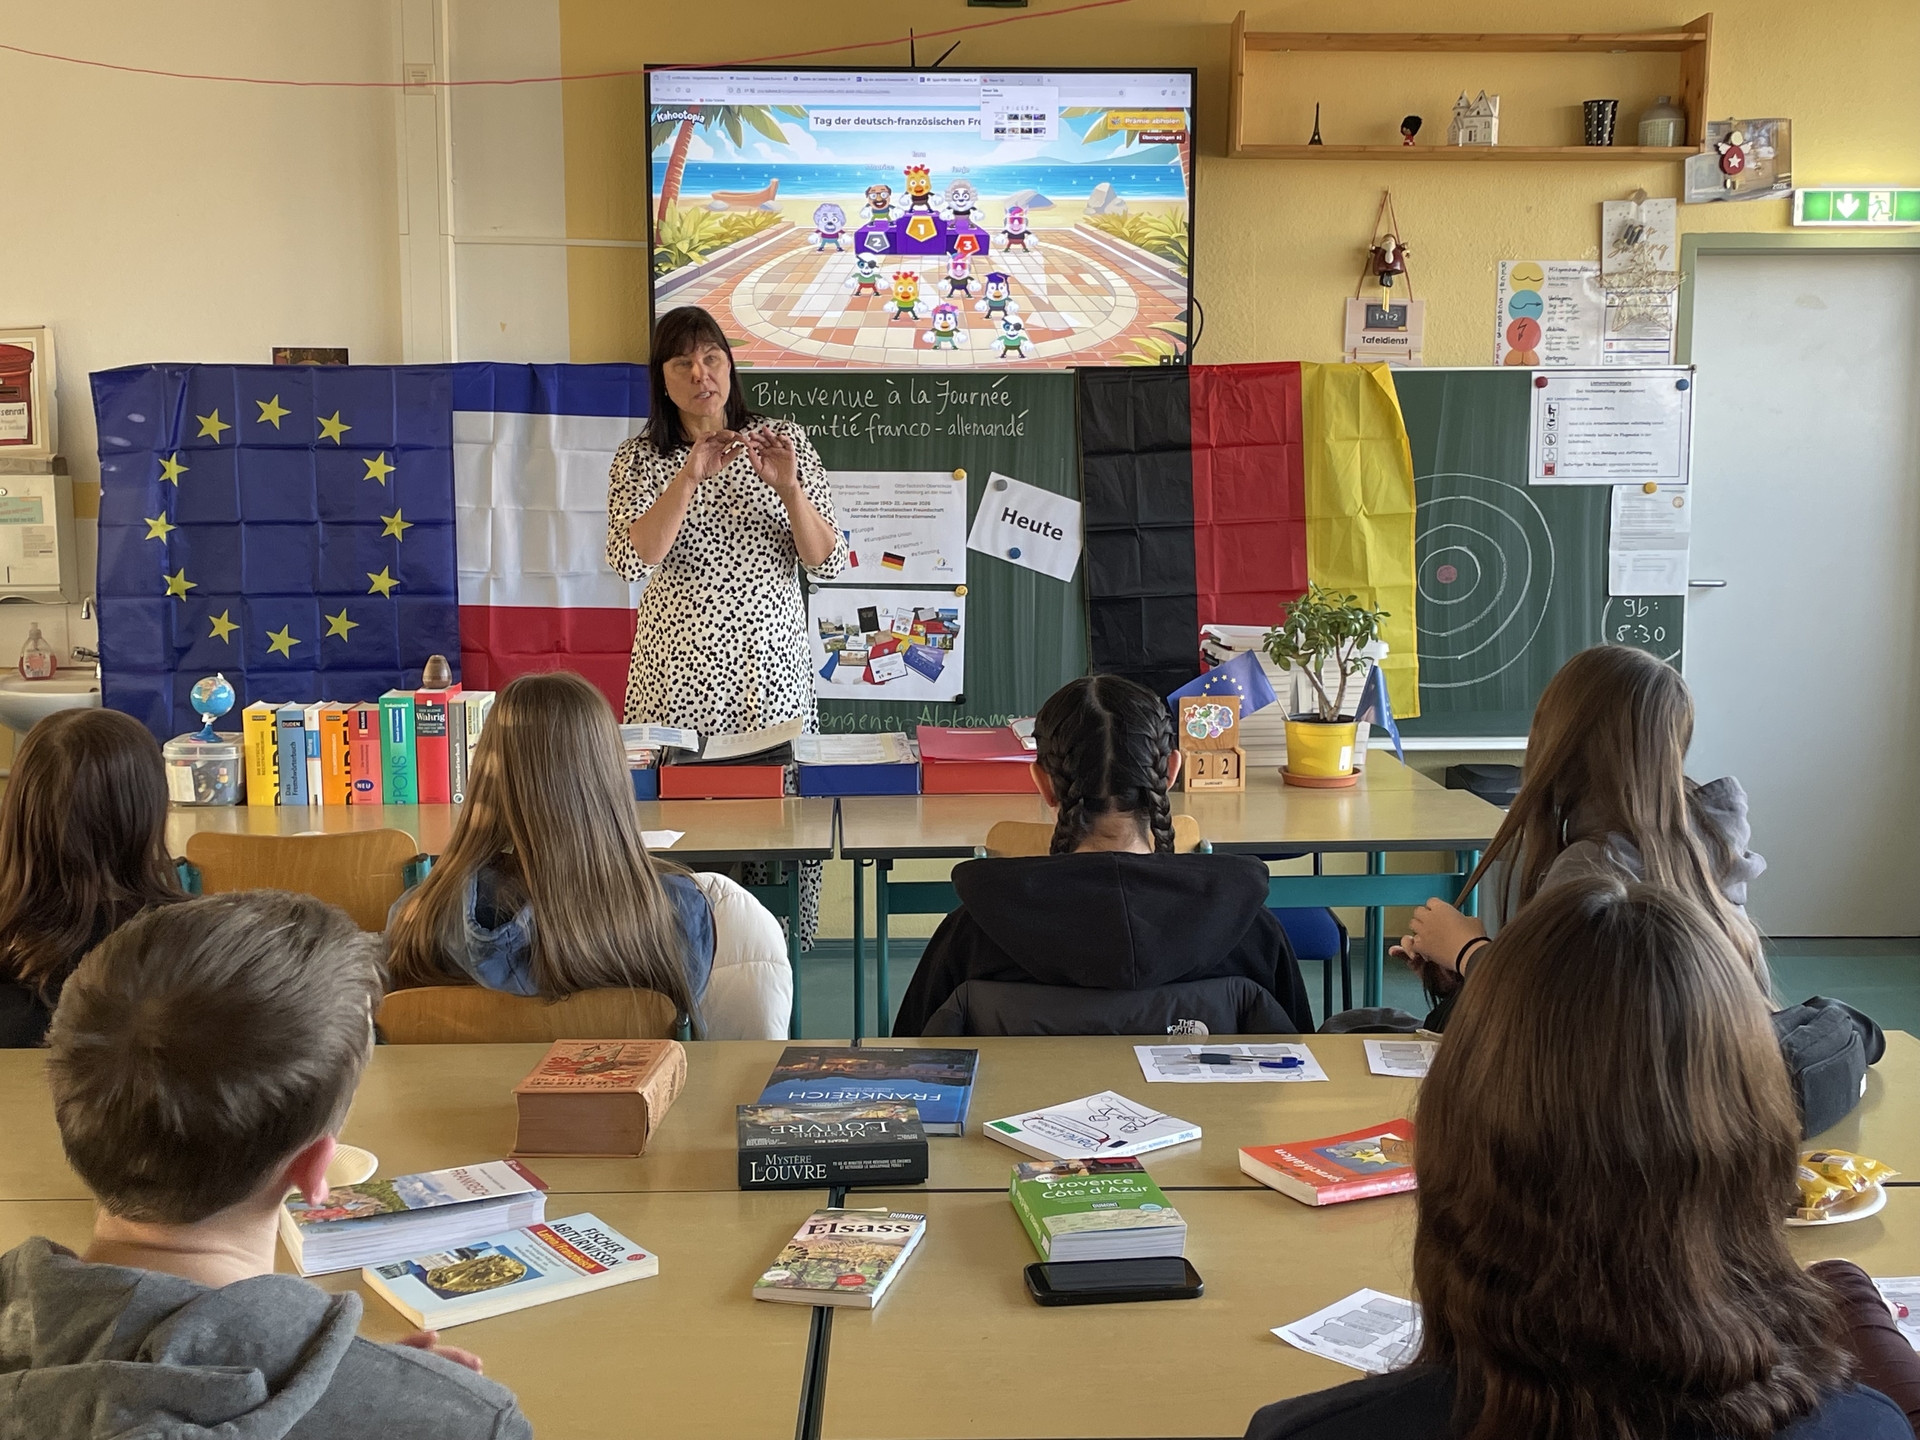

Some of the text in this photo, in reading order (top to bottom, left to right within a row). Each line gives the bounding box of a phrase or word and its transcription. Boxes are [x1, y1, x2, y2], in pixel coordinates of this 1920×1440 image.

[656, 110, 705, 124] Kahootopia
[814, 117, 832, 126] Tag
[834, 117, 851, 125] der
[854, 117, 965, 126] deutsch-französischen
[1125, 116, 1150, 124] Prämie
[917, 224, 925, 236] 1
[872, 237, 882, 246] 2
[963, 240, 973, 250] 3
[1362, 336, 1408, 344] Tafeldienst
[752, 375, 1013, 415] Bienvenue à la Journée
[1001, 506, 1063, 541] Heute
[1616, 624, 1666, 643] 8:30
[415, 712, 446, 722] Wahrig
[819, 711, 914, 733] engener
[290, 741, 299, 796] Fremdwörterbuch
[1197, 758, 1229, 774] 2 2
[391, 755, 408, 798] PONS
[1177, 1018, 1196, 1027] THE
[788, 1091, 942, 1101] FRANKREICH
[769, 1120, 891, 1135] LOUVRE
[765, 1154, 812, 1166] MYSTÈRE
[750, 1161, 827, 1183] LOUVRE
[1046, 1178, 1134, 1190] Provence
[1042, 1187, 1085, 1199] Côte
[889, 1212, 924, 1221] DUMONT
[807, 1222, 911, 1235] Elsass
[550, 1223, 622, 1267] ABITURWISSEN
[581, 1227, 625, 1254] FISCHER
